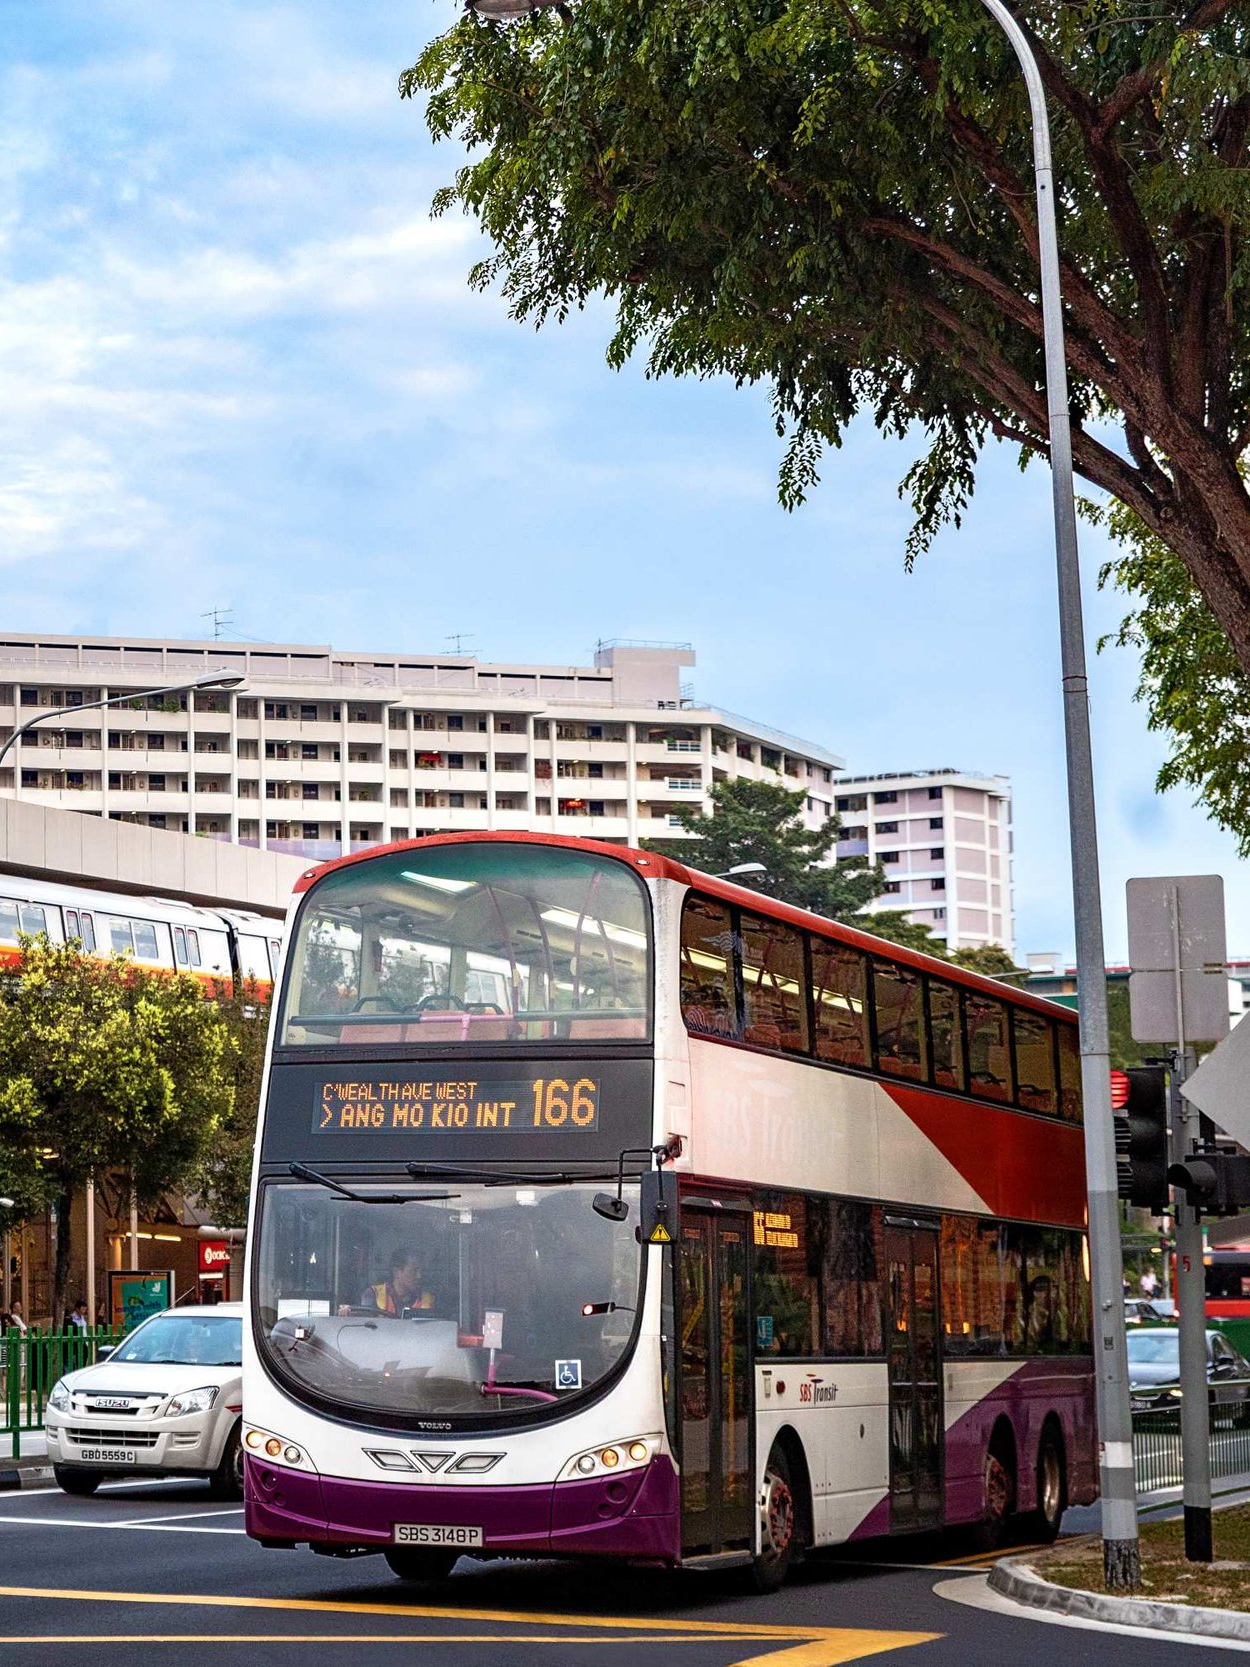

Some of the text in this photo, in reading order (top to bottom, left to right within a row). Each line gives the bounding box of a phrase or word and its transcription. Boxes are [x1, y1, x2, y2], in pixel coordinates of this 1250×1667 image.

[401, 1082, 433, 1100] AVE
[436, 1082, 478, 1101] WEST
[532, 1078, 596, 1127] 166
[340, 1102, 516, 1128] ANG MO KIO INT
[1182, 1255, 1190, 1272] 5
[799, 1378, 838, 1405] SBS Transit
[96, 1399, 130, 1408] ISUZU
[418, 1421, 452, 1430] VOLVO
[81, 1449, 134, 1461] GBD5559C
[398, 1526, 479, 1543] SBS3148P
